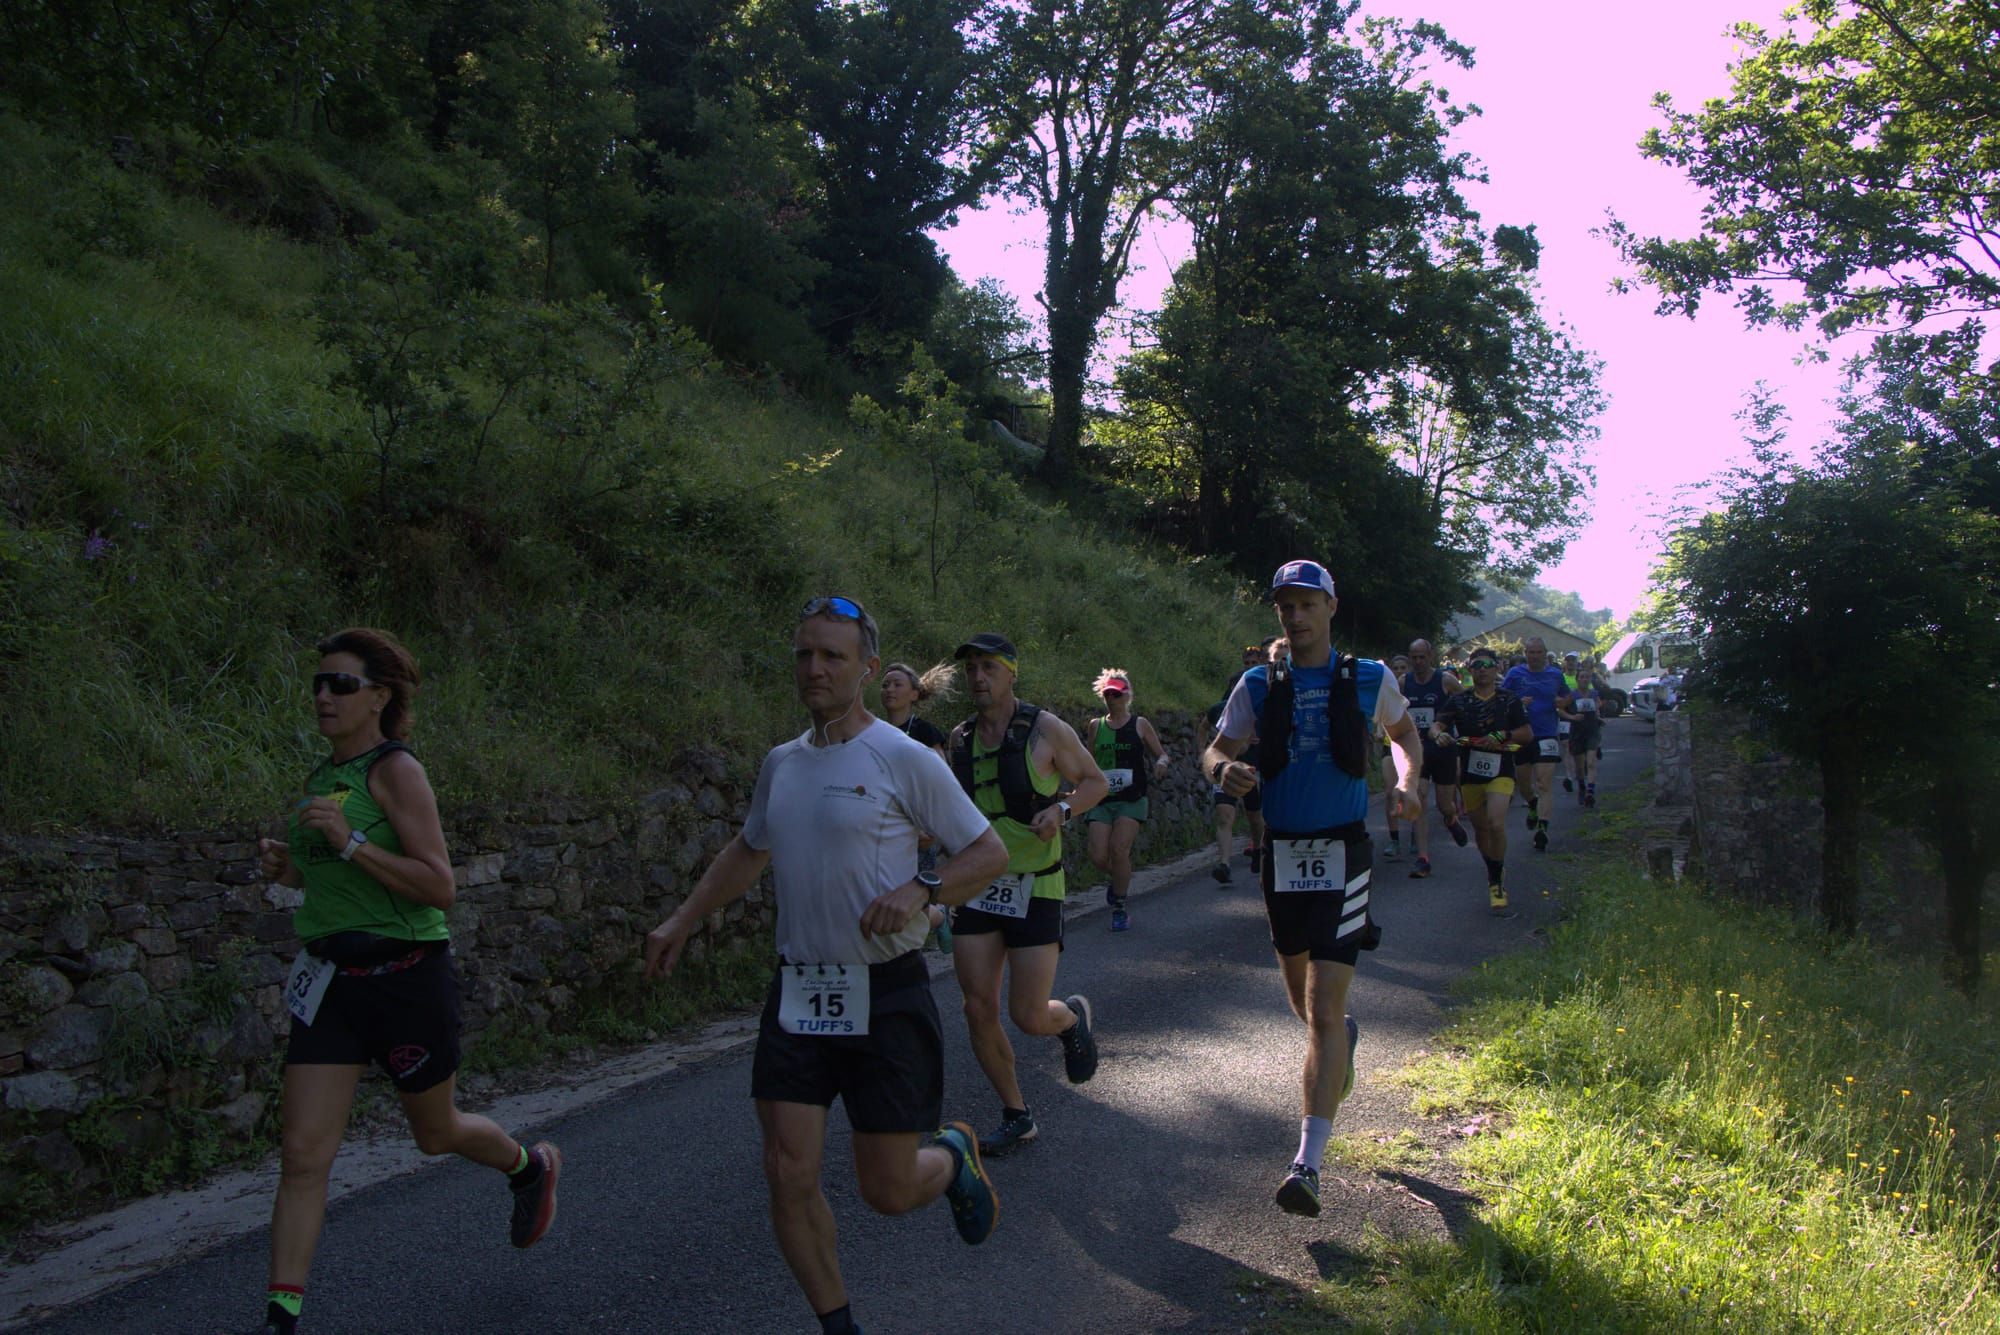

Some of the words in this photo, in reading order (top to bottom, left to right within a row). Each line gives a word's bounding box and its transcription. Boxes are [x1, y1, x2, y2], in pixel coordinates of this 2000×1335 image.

[1476, 760, 1491, 770] 60
[1110, 776, 1124, 787] 34
[1296, 859, 1326, 878] 16
[1289, 879, 1333, 890] TUFF'S
[985, 885, 1013, 904] 28
[979, 900, 1017, 916] TUFF'S
[293, 969, 313, 998] 53
[808, 992, 845, 1018] 15
[797, 1019, 855, 1032] TUFF'S
